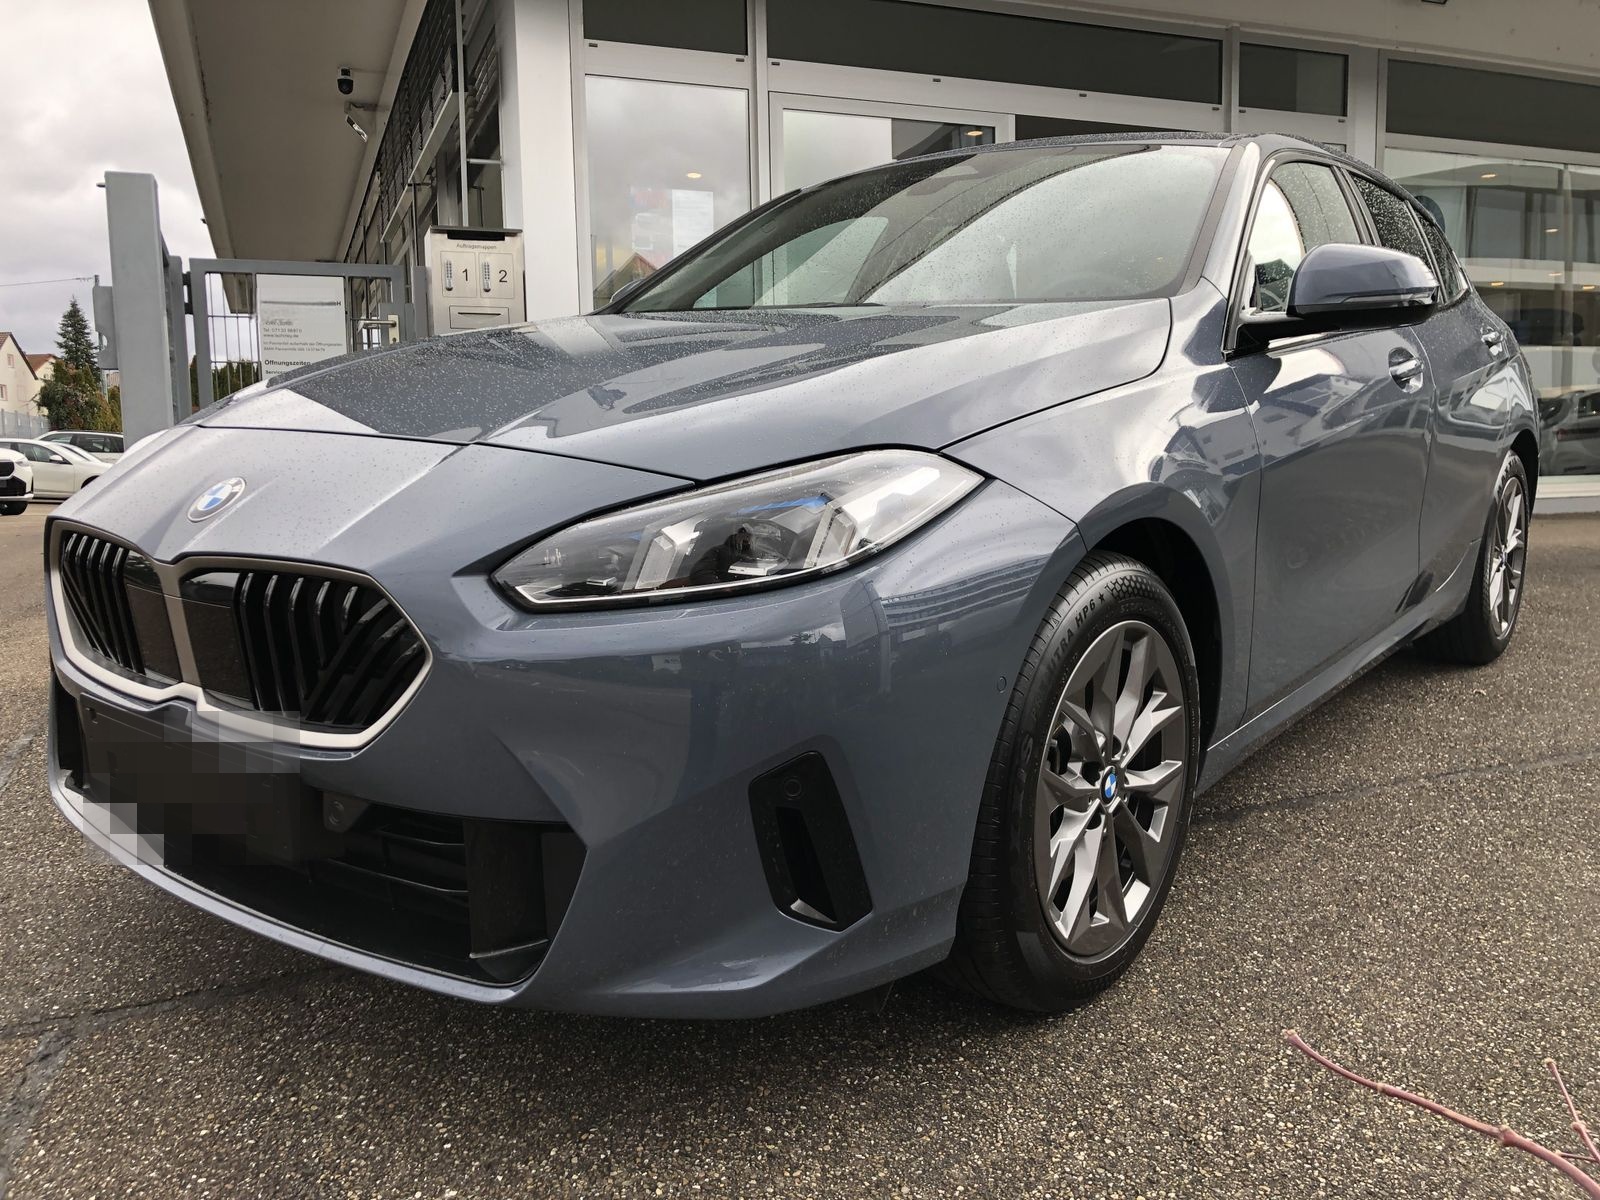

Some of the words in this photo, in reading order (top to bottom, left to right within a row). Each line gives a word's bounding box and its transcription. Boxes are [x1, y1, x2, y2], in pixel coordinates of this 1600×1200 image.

[462, 268, 468, 282] 1
[498, 269, 508, 283] 2
[1074, 598, 1097, 628] HP6
